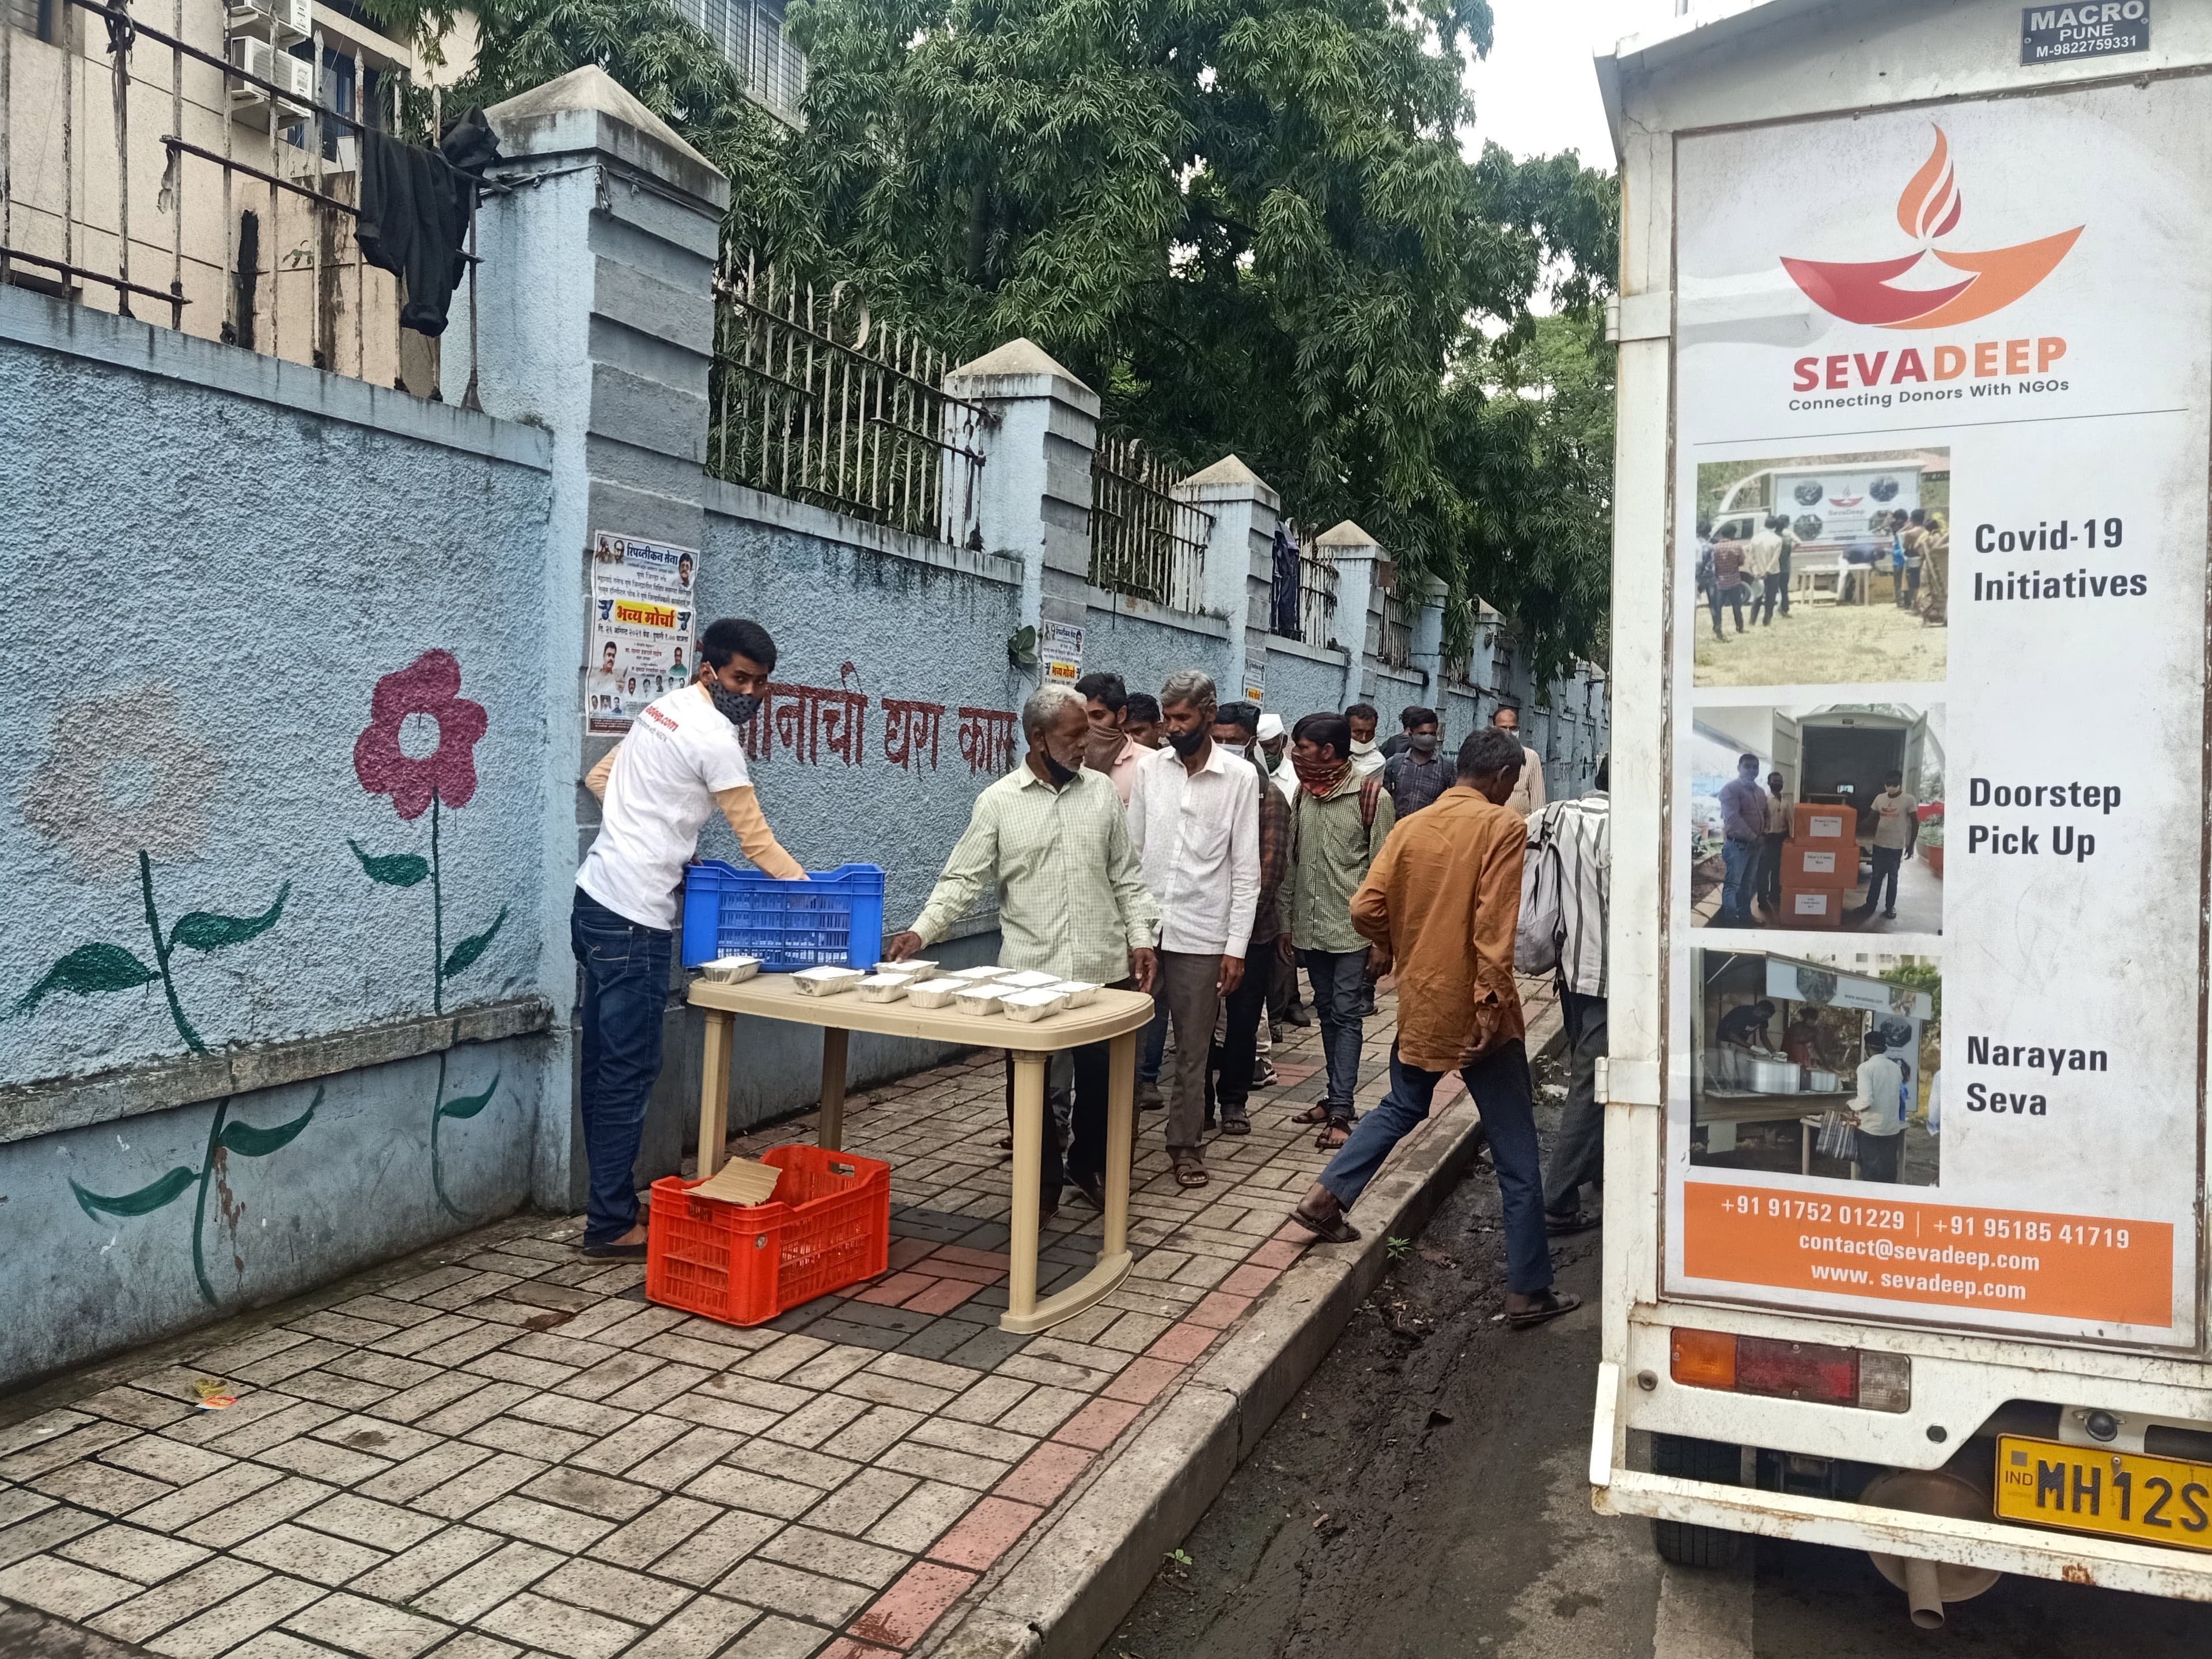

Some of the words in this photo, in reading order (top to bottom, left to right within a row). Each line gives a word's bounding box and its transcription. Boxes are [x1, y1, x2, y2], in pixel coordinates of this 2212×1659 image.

[2031, 0, 2145, 31] MACRO
[2059, 24, 2113, 41] PUNE
[2036, 35, 2136, 58] M-9822759331
[1793, 337, 2067, 392] SEVADEEP
[1789, 393, 1892, 411] Connecting
[1899, 387, 1963, 406] Donors
[1969, 382, 2012, 398] With
[2019, 378, 2070, 394] NGOs
[1975, 517, 2123, 554] Covid-19
[1975, 569, 2147, 601] Initiatives
[617, 606, 642, 623] भव्य
[645, 607, 675, 628] मोर्चा
[1970, 778, 2121, 815] Doorstep
[1969, 825, 2039, 854] Pick
[2052, 825, 2095, 863] Up
[1968, 1036, 2107, 1076] Narayan
[1967, 1082, 2047, 1116] Seva
[1722, 1195, 1759, 1215] +91
[1768, 1198, 1832, 1223] 91752
[1839, 1205, 1904, 1230] 01229
[1934, 1215, 1974, 1236] +91
[1984, 1218, 2052, 1242] 95185
[2059, 1224, 2130, 1249] 41719
[1800, 1234, 2040, 1271] contact@sevadeep.com
[1811, 1264, 1874, 1285] www.
[1881, 1272, 2027, 1300] sevadeep.com
[2005, 1470, 2033, 1486] IND
